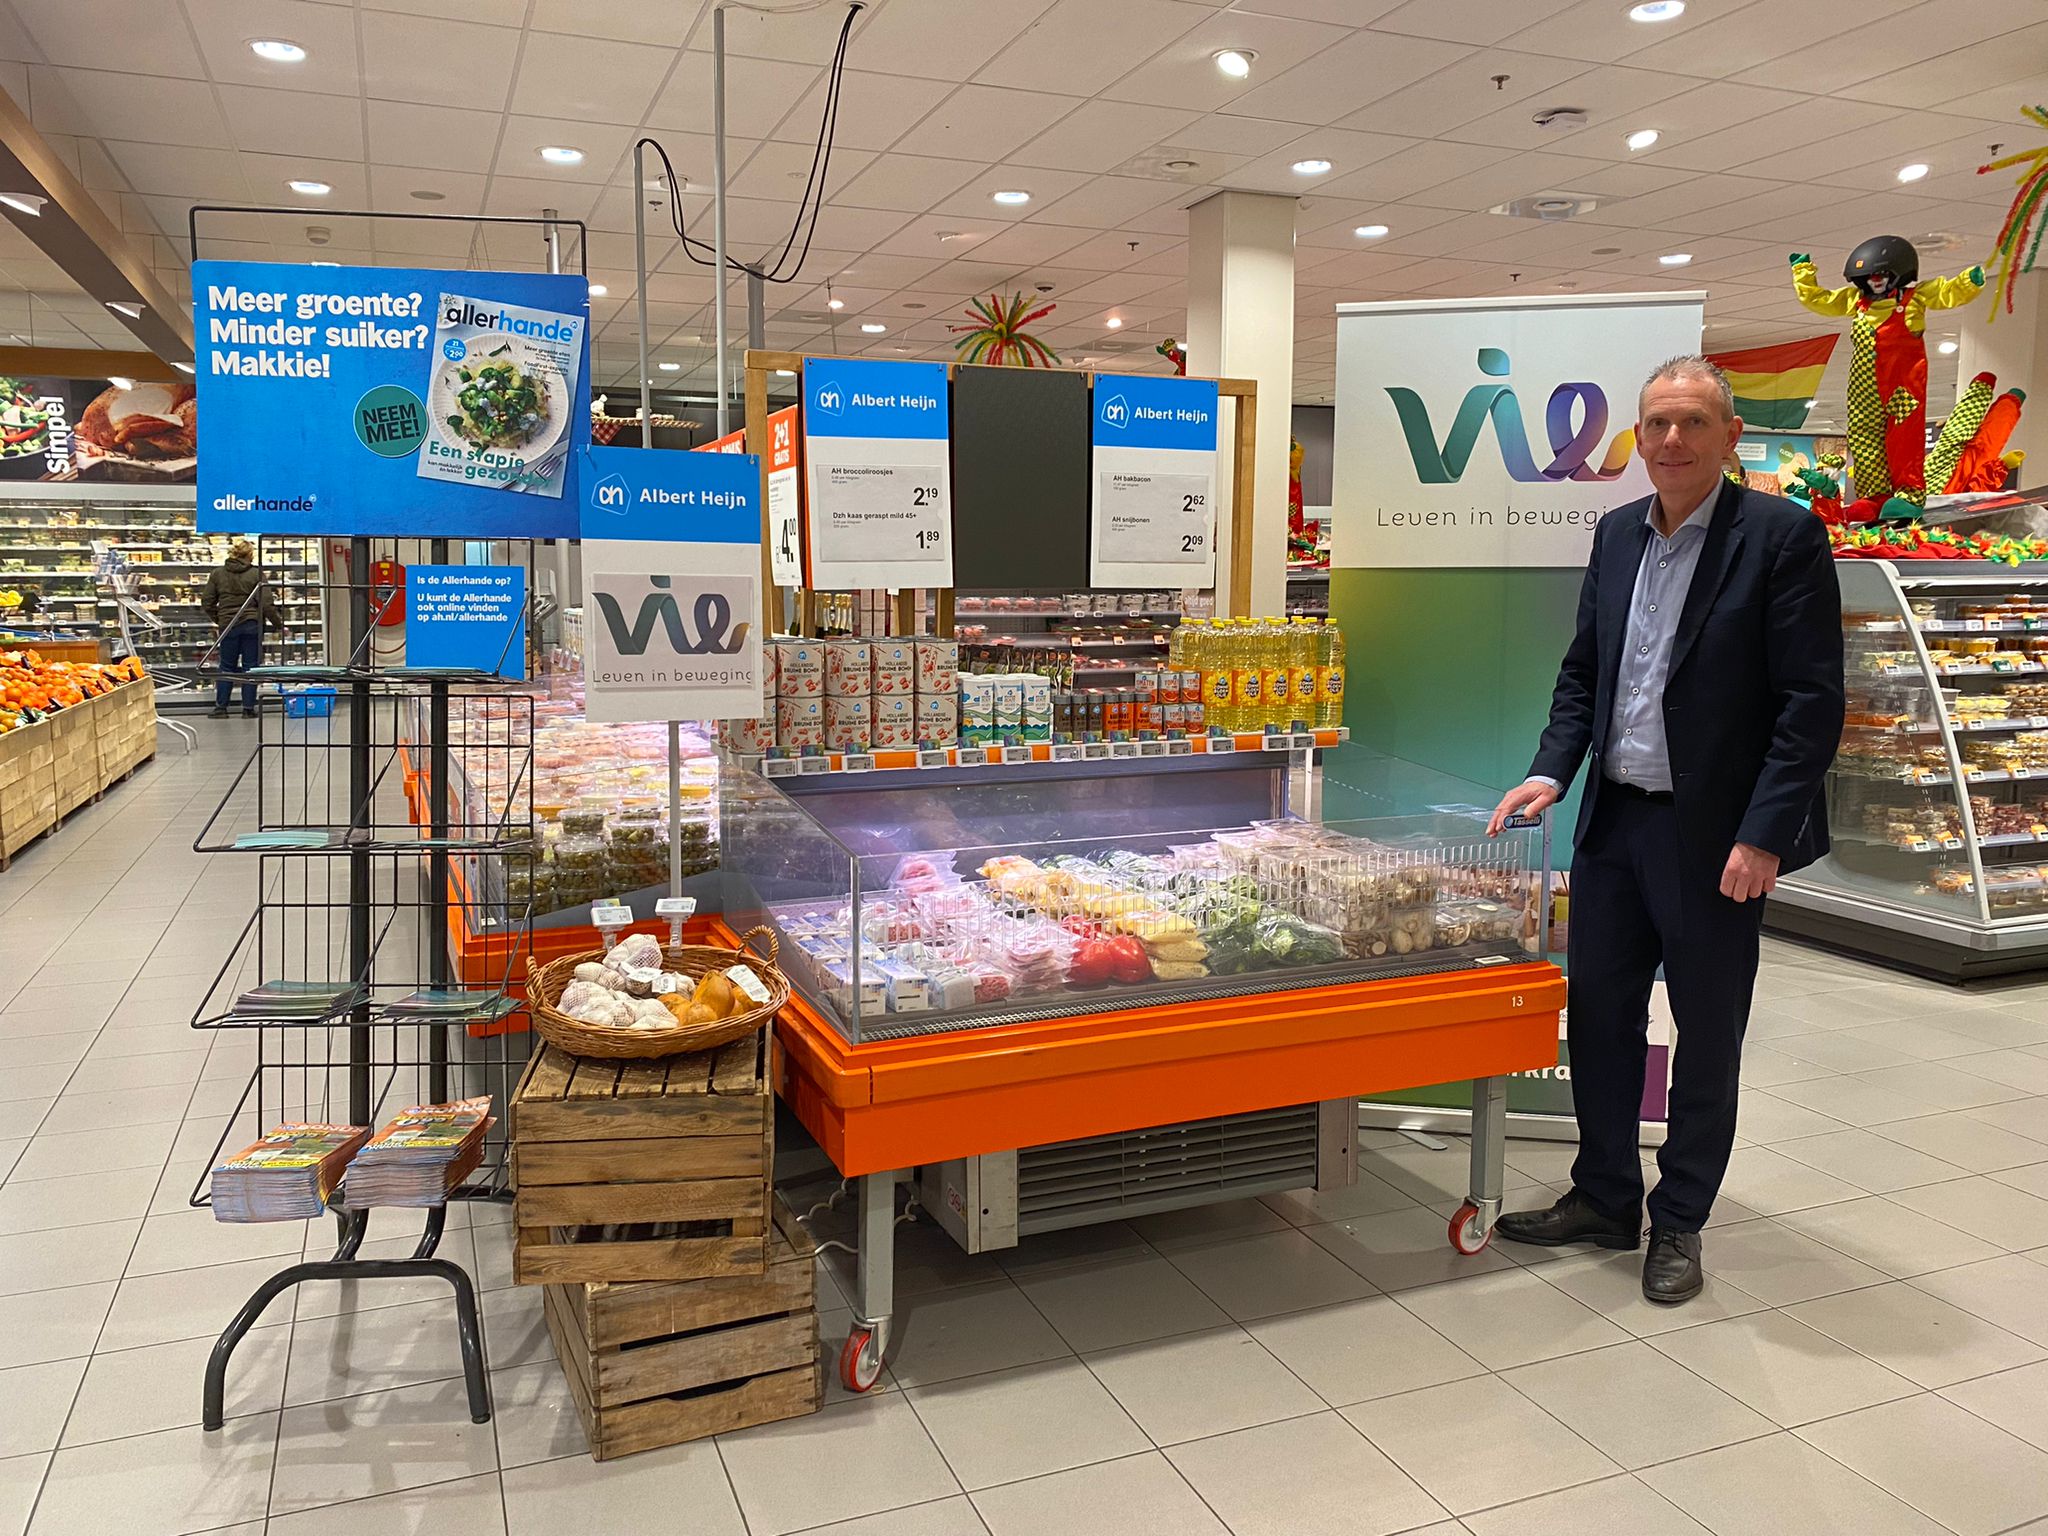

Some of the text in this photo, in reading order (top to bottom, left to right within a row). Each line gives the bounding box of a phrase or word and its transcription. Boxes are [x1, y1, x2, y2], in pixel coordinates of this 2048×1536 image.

[208, 285, 422, 319] Meer groente?
[446, 303, 573, 342] allerhande
[210, 317, 429, 349] Minder suiker?
[211, 350, 331, 378] Makkie!
[852, 393, 896, 407] Albert
[900, 395, 937, 411] Heijn
[362, 403, 416, 425] NEEM
[1134, 407, 1173, 420] Albert
[1176, 409, 1208, 424] Heijn
[40, 396, 70, 474] simpel
[366, 419, 420, 444] MEE!
[429, 440, 463, 460] Een
[831, 467, 894, 477] AH broccoliroosjes
[213, 493, 313, 512] allerhande
[640, 488, 695, 504] Albert
[701, 491, 746, 509] Heijn
[913, 487, 938, 506] 2.19
[1182, 494, 1205, 512] 2.62
[1377, 507, 1457, 527] Leven
[1470, 507, 1493, 525] in
[915, 530, 940, 549] 1.89
[1181, 535, 1204, 552] 2.09
[417, 576, 511, 586] Is de Allerhande op?
[417, 593, 512, 602] U kunt de Allerhande
[417, 603, 499, 612] ook online vinden
[592, 575, 751, 655] vie
[417, 613, 508, 622] op ah.nl/allerhande
[593, 670, 644, 683] Leven
[652, 669, 667, 682] in
[1512, 995, 1524, 1007] 13
